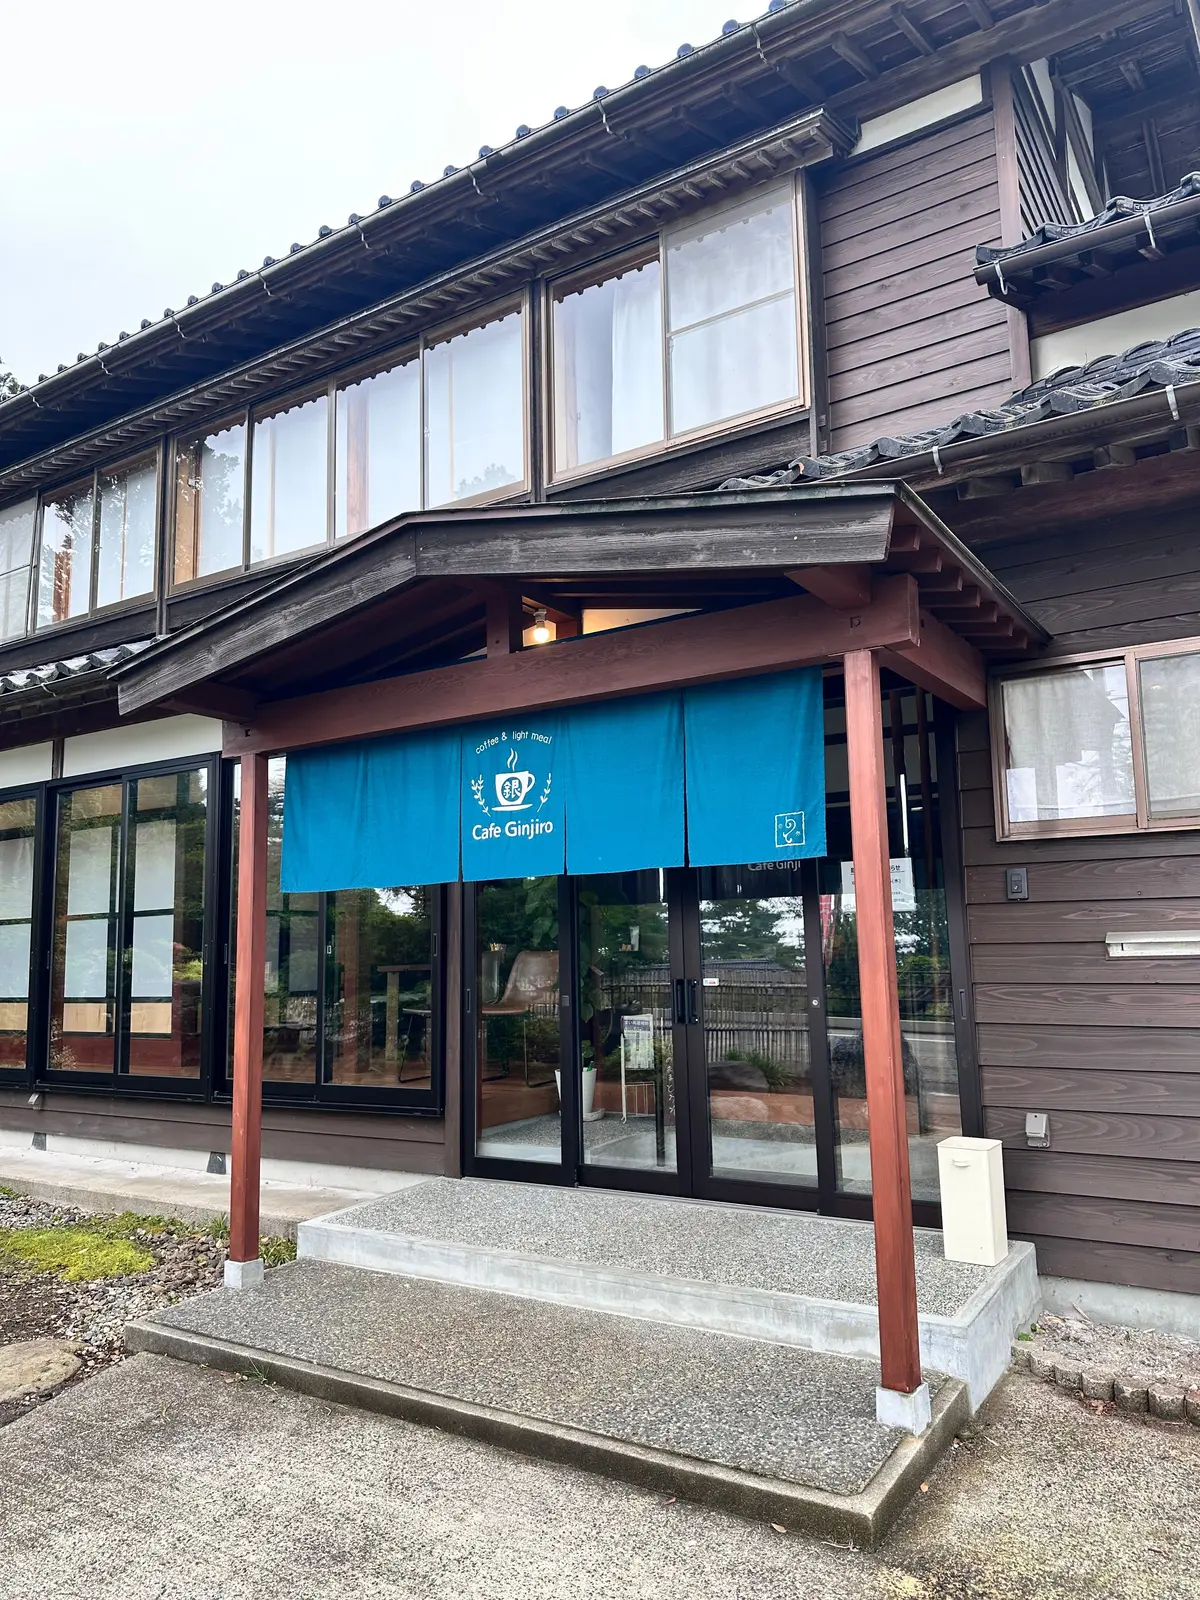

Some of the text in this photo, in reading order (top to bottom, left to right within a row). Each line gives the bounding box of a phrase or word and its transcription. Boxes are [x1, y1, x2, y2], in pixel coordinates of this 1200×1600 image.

[475, 730, 553, 755] coffee & light meal
[503, 779, 522, 799] 銀
[472, 818, 554, 840] Cafe Ginjiro
